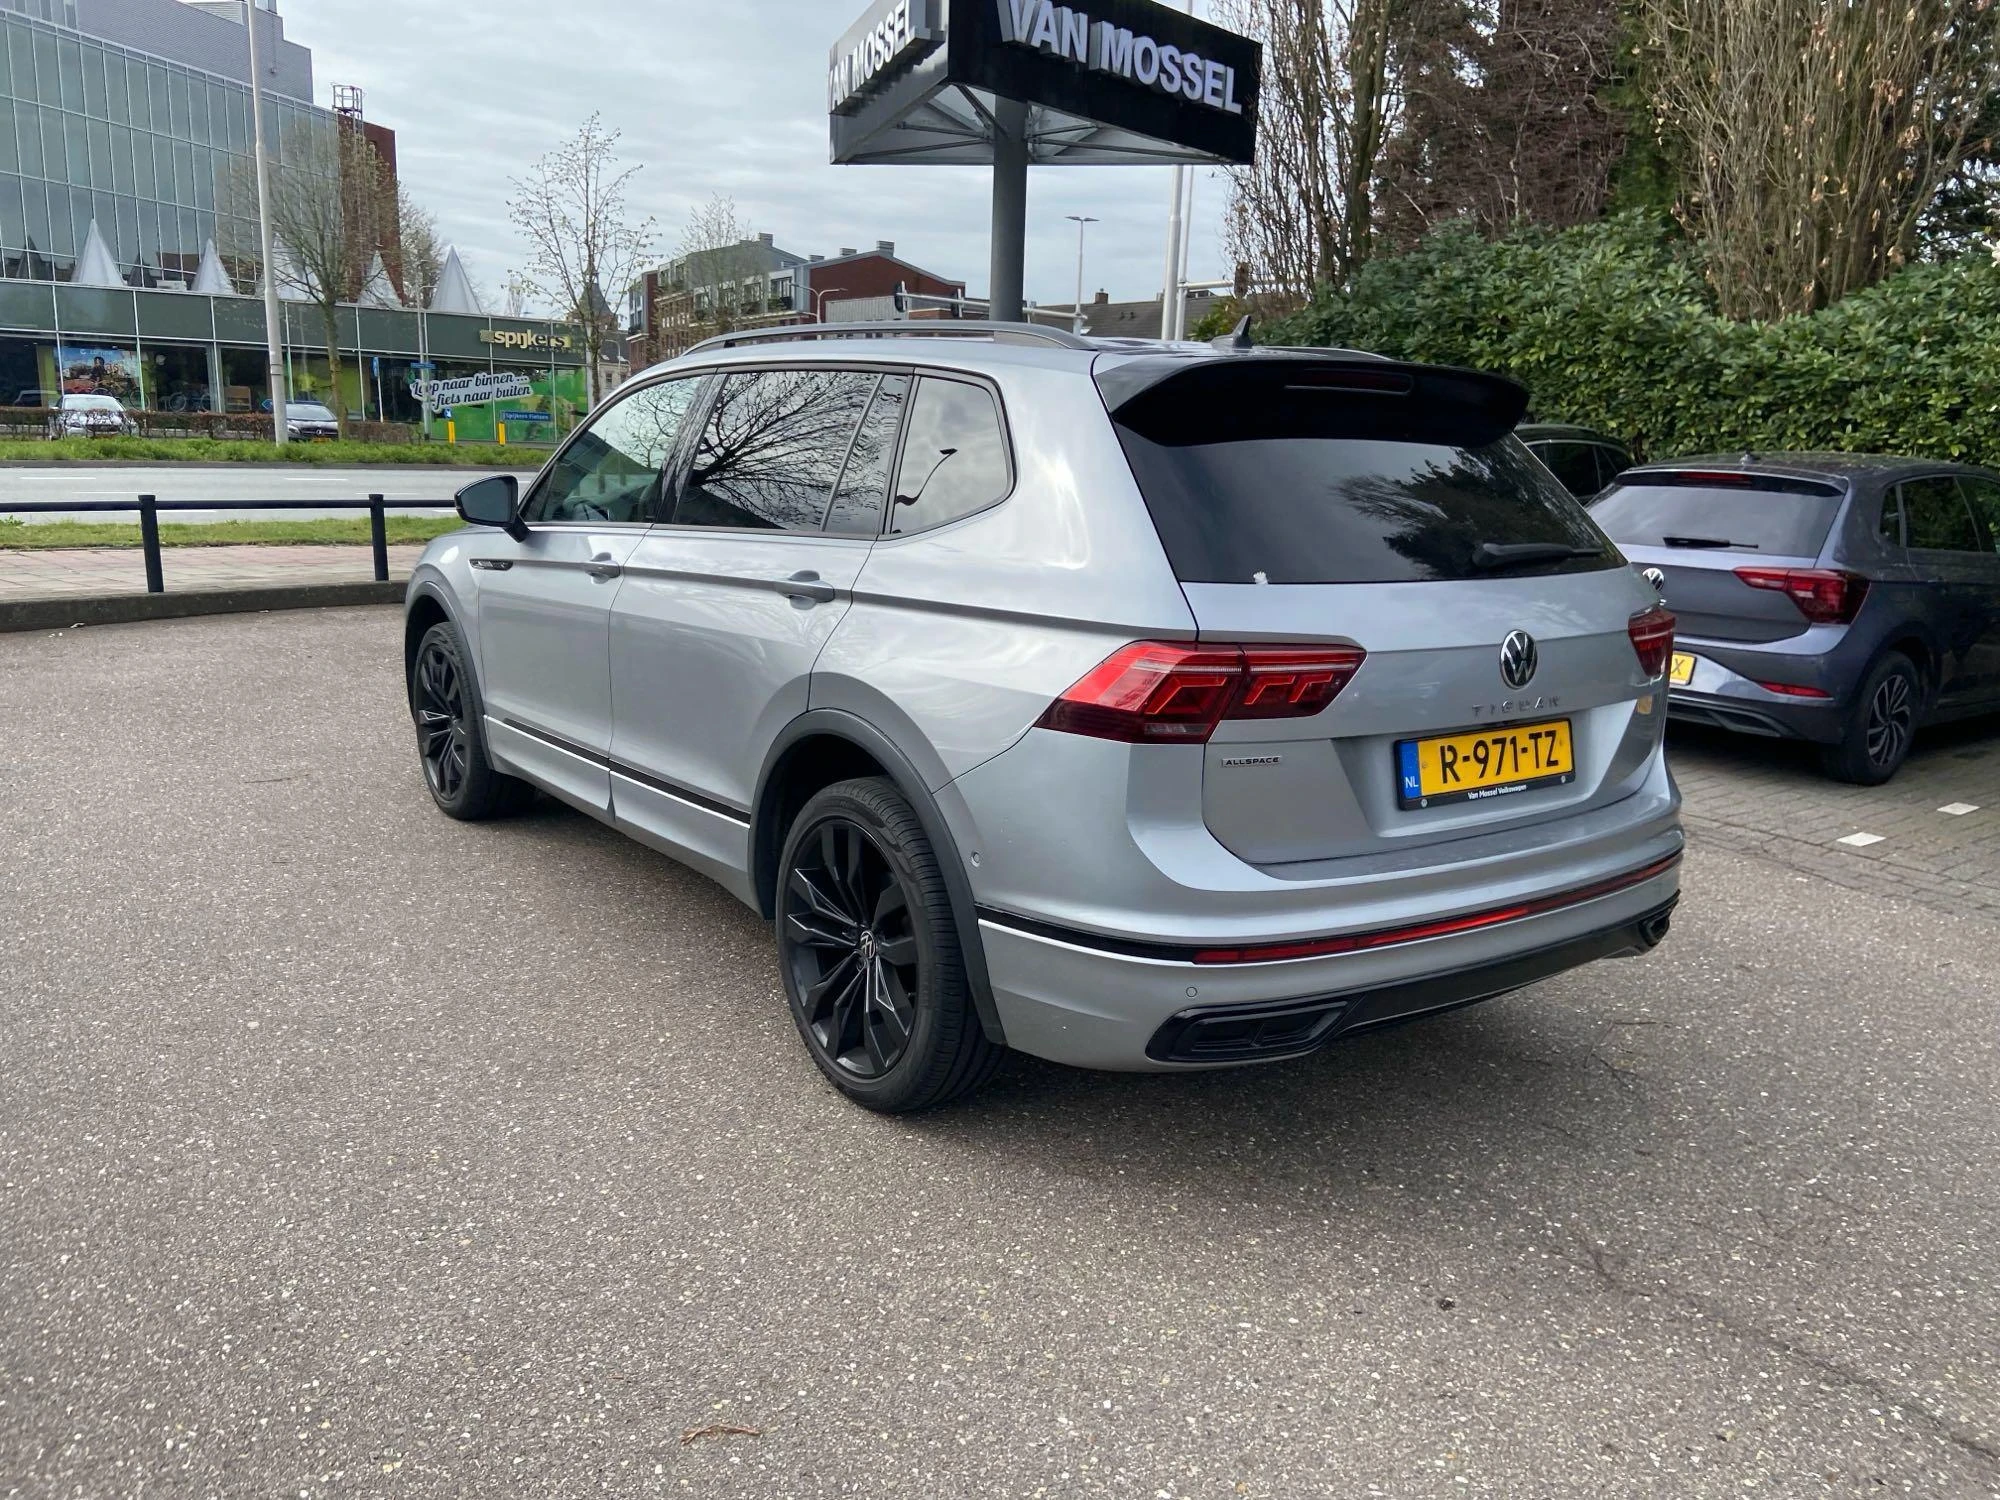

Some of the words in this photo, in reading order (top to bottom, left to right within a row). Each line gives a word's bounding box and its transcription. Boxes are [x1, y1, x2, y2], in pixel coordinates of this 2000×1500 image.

[852, 0, 915, 92] MOSSEL
[1009, 0, 1088, 63] VAN
[1101, 20, 1242, 114] MOSSEL
[494, 328, 567, 349] spijkers
[442, 379, 472, 391] naar
[475, 374, 514, 387] binnen
[464, 391, 492, 403] naar
[496, 385, 531, 398] buiten
[1225, 757, 1279, 766] ALLSPACE
[1440, 729, 1559, 784] R-971-TZ
[1405, 776, 1419, 789] NL
[1467, 792, 1479, 800] Van
[1479, 787, 1498, 798] Mossel
[1498, 784, 1527, 795] Volkswagen
